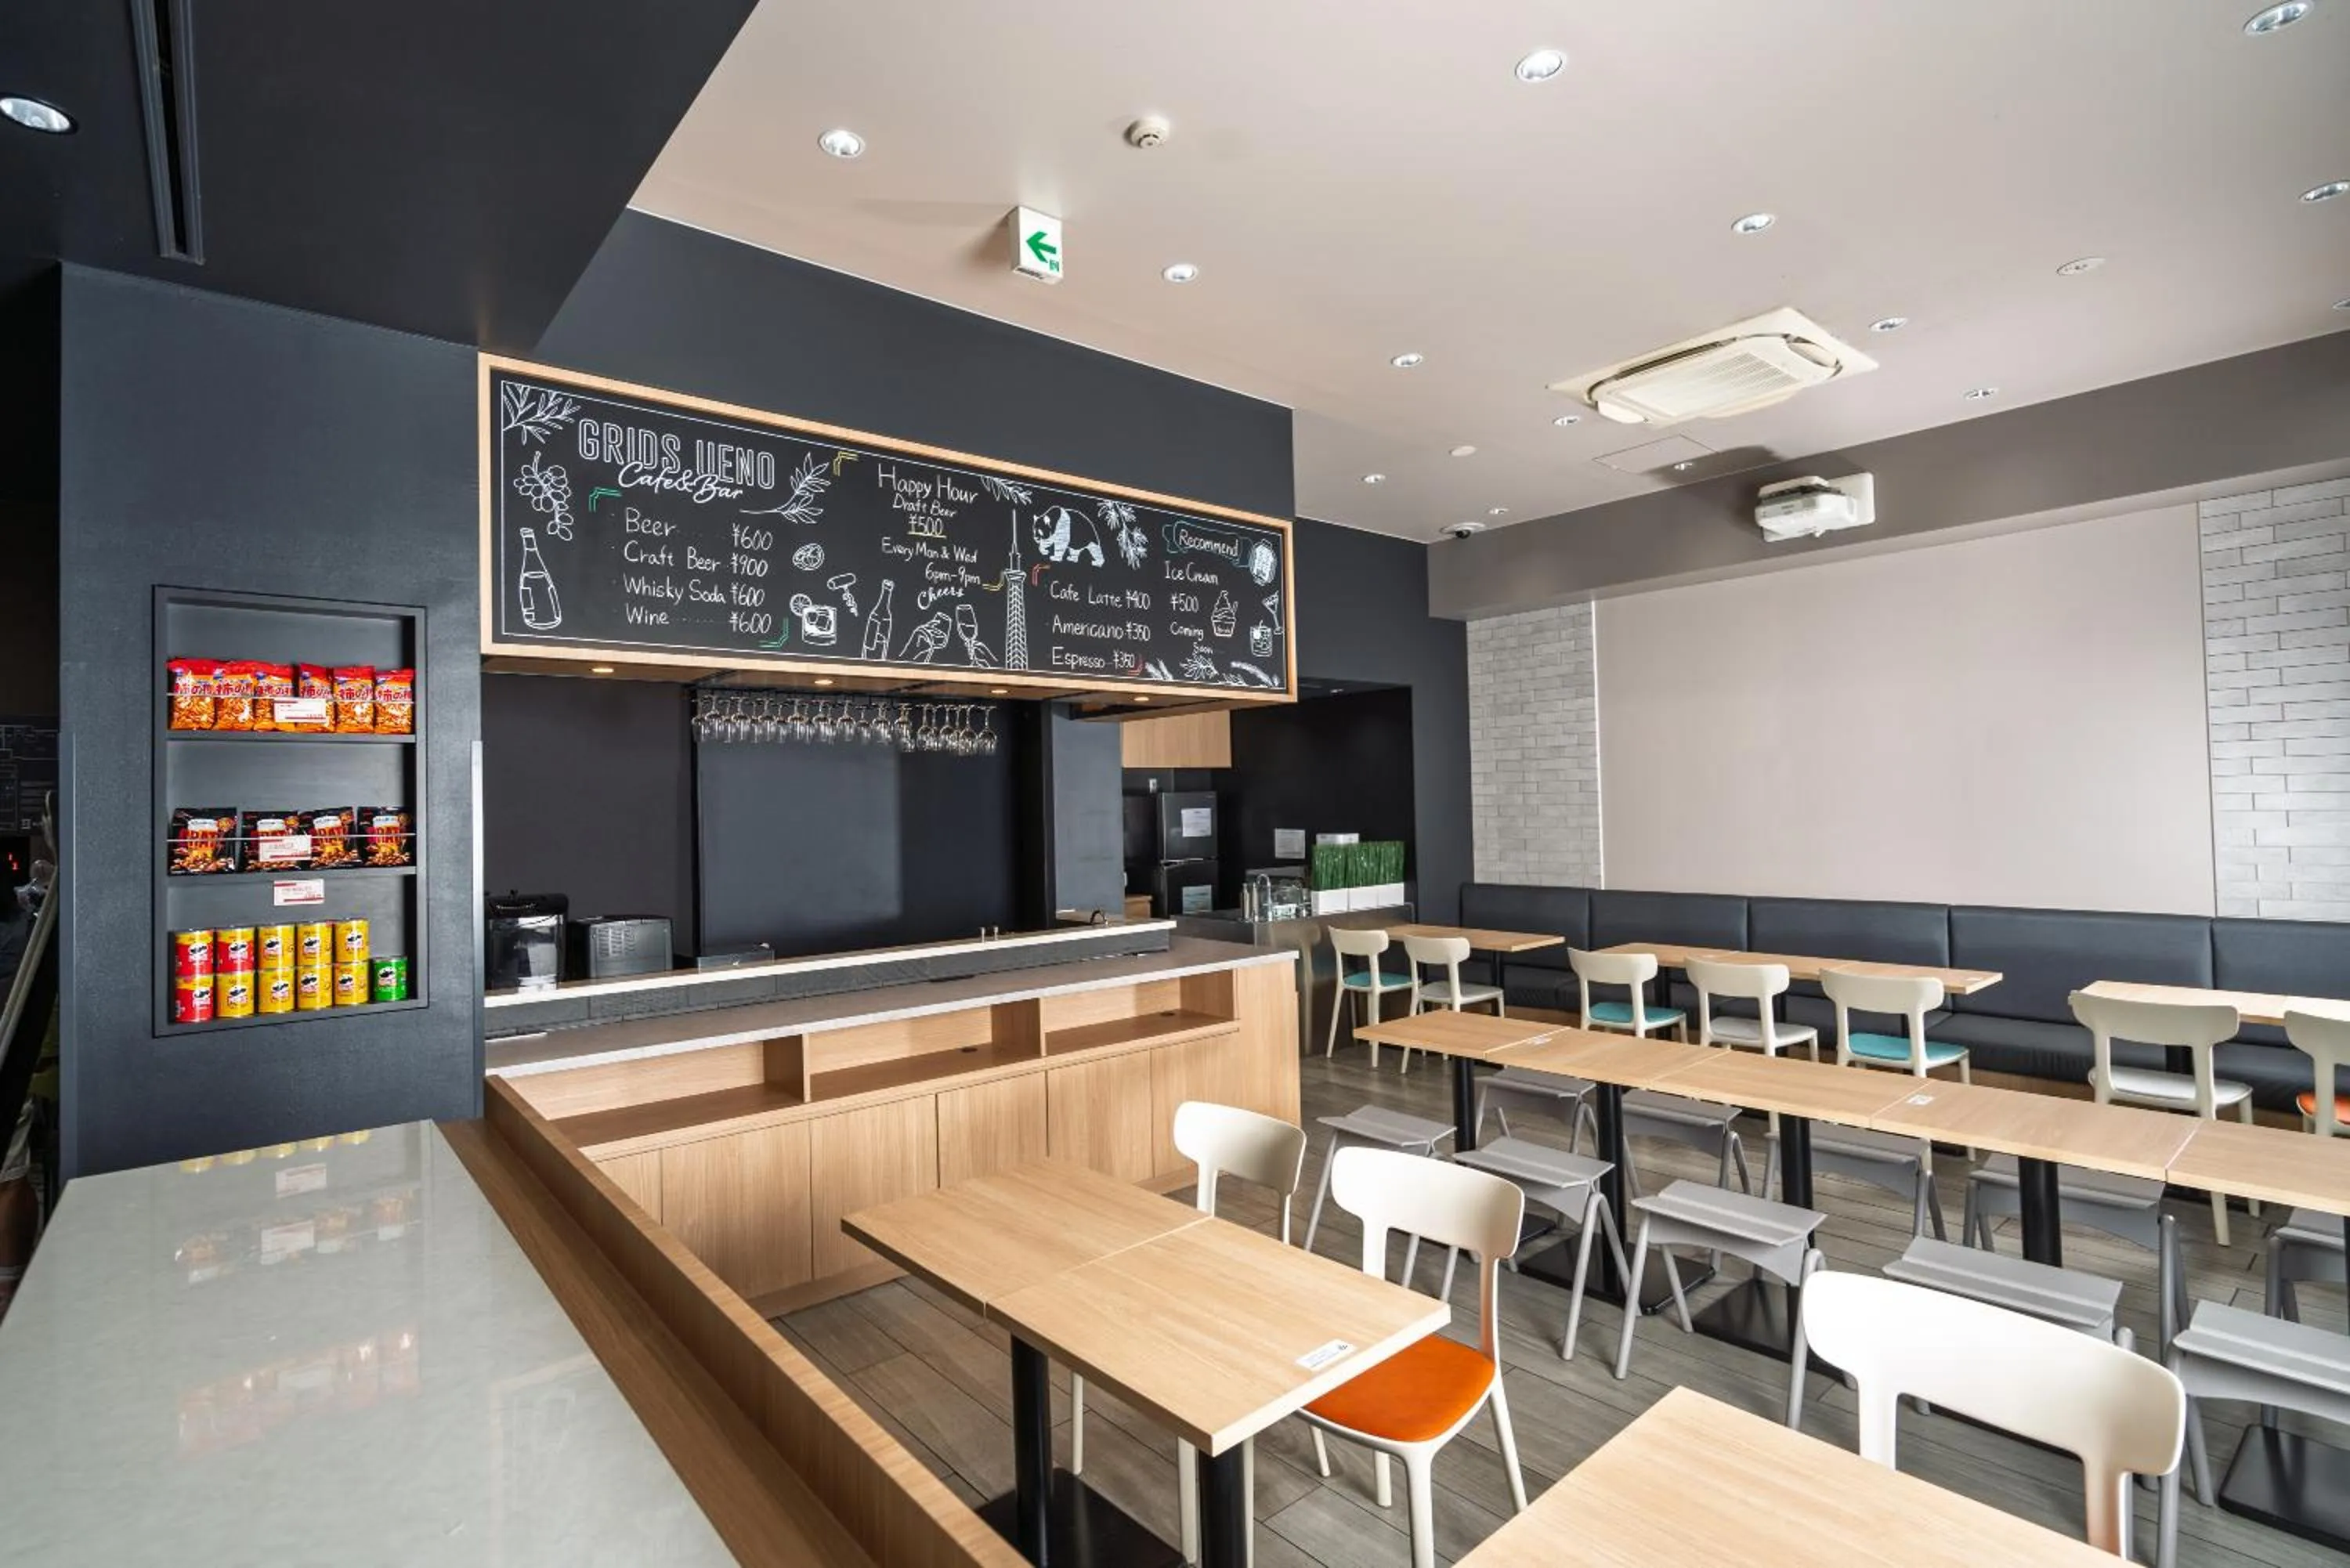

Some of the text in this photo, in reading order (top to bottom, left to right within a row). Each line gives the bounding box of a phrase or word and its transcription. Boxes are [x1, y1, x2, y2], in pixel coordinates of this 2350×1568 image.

[578, 419, 776, 490] GRIDS UENO
[878, 463, 978, 504] Happy Hour
[892, 493, 956, 518] Draft Beer
[626, 507, 773, 551] Beer ¥600
[908, 513, 944, 536] ¥500
[882, 537, 914, 562] Every
[953, 544, 978, 563] Wed
[1178, 529, 1238, 557] Recommend
[624, 540, 768, 576] Craft Beer ¥900
[1164, 559, 1219, 585] Ice Cream
[623, 573, 765, 607] Whisky Soda ¥600
[1050, 580, 1151, 610] Cafe Latte ¥400
[1170, 591, 1199, 613] ¥500
[624, 602, 772, 634] Wine ¥600
[1052, 614, 1124, 640] Americano
[1170, 621, 1204, 641] Coming
[1052, 646, 1105, 670] Espresso
[1192, 641, 1213, 656] Soon
